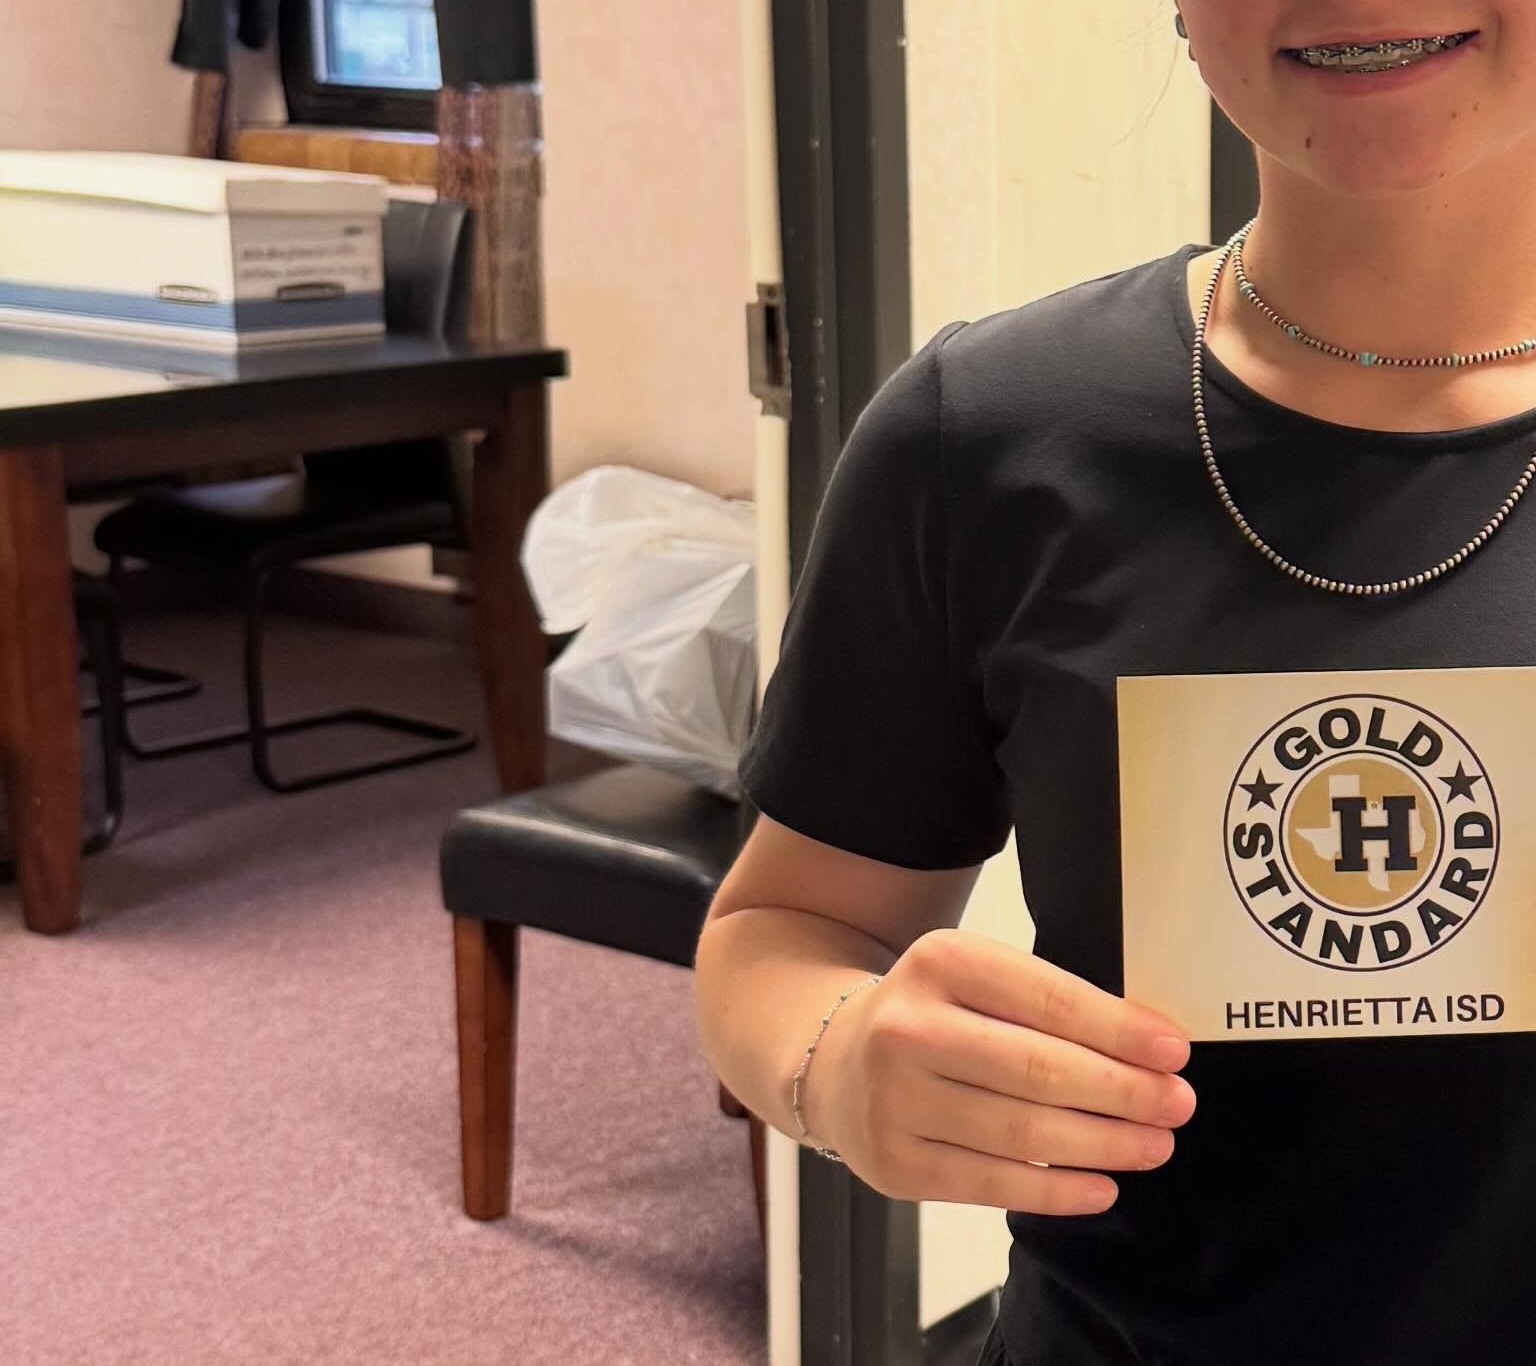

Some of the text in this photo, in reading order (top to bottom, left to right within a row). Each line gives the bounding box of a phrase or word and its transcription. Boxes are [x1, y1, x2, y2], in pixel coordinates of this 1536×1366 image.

[1273, 707, 1444, 771] GOLD
[1331, 795, 1418, 872] H
[1232, 810, 1494, 965] STANDARD
[1225, 993, 1506, 1030] HENRIETTA ISD
